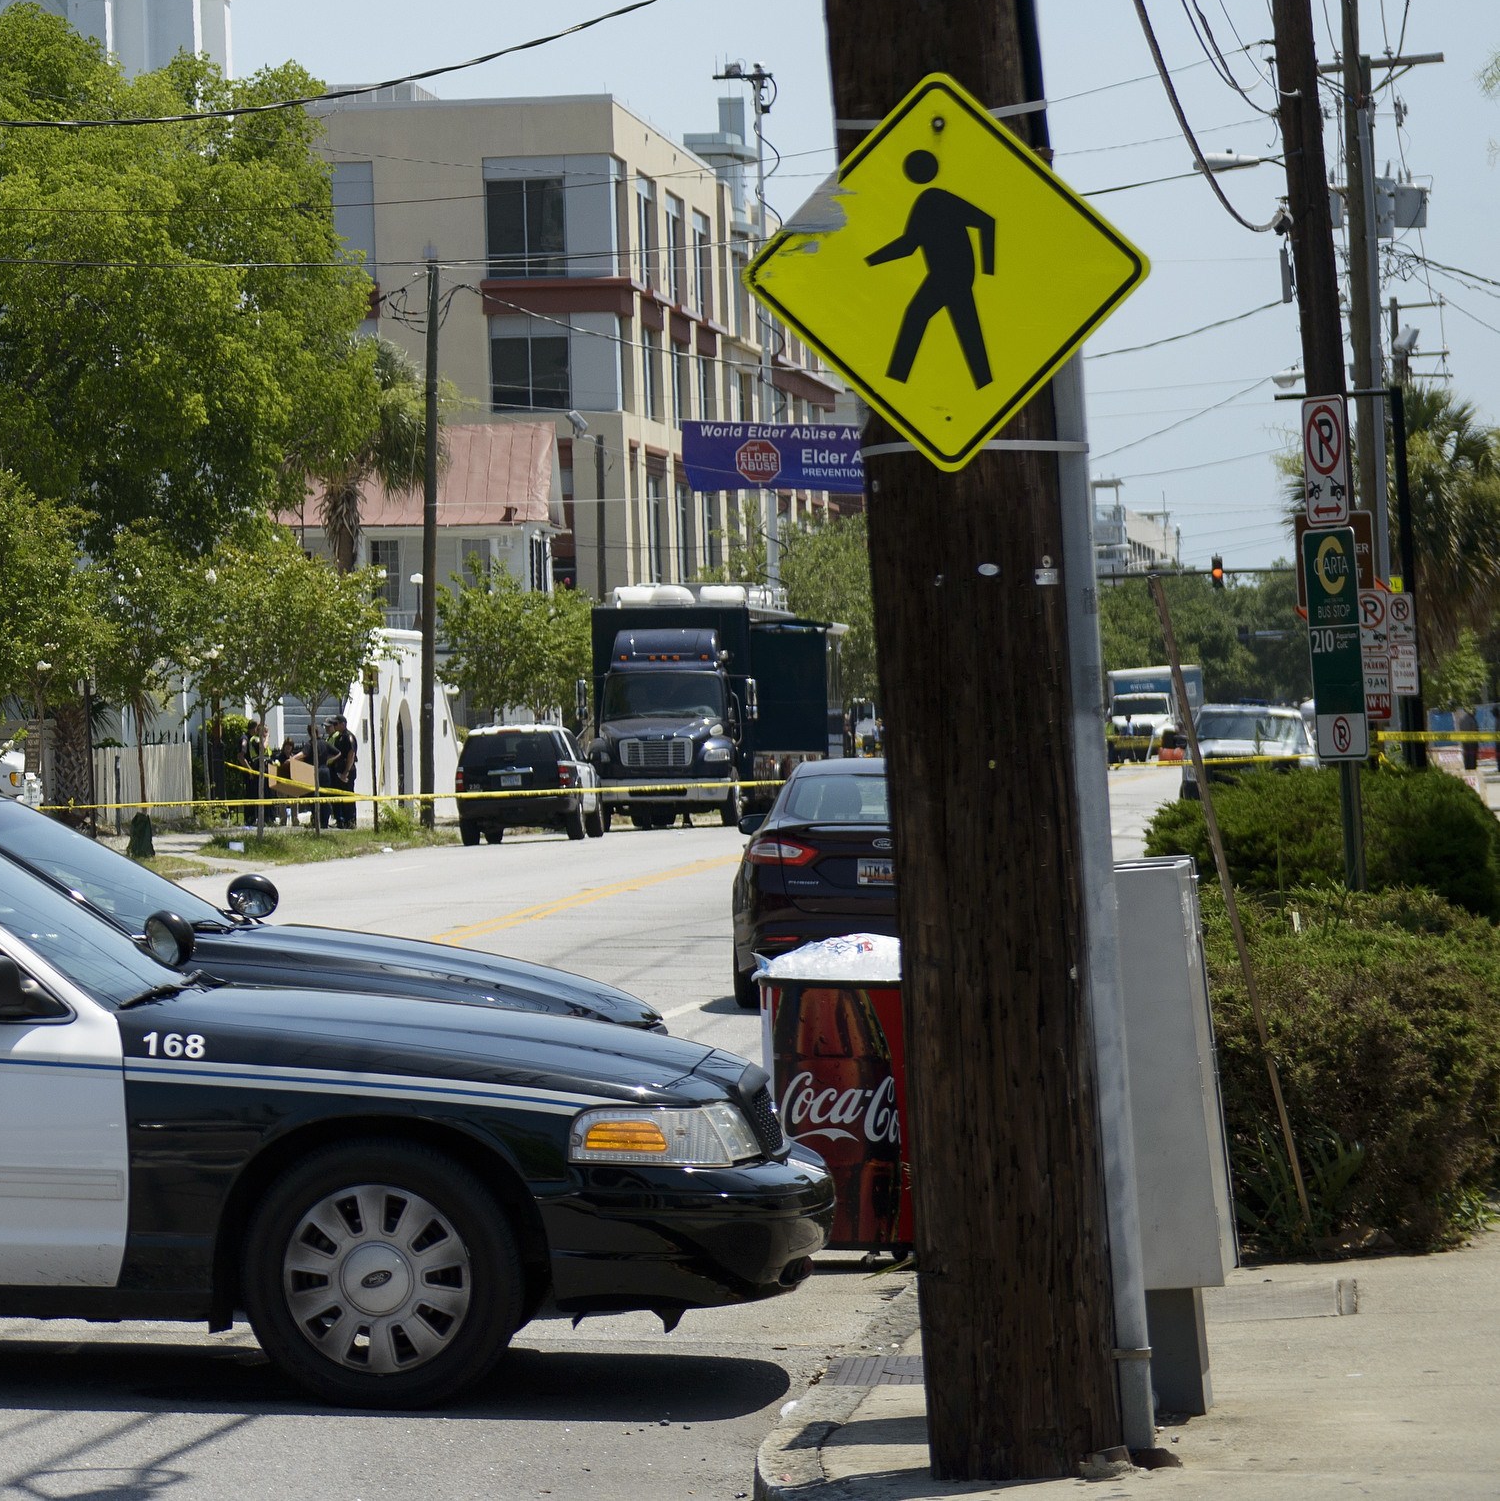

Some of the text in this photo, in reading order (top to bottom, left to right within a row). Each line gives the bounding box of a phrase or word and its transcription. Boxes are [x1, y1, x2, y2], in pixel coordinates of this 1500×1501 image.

[700, 424, 862, 440] World Elder Abuse Aw
[739, 452, 777, 462] ELDER
[801, 449, 864, 464] Elder A
[739, 462, 778, 472] ABUSE
[802, 468, 865, 477] PREVENTION
[1313, 555, 1349, 576] CARTA
[1317, 604, 1350, 618] BUS STOP
[1311, 629, 1335, 653] 210
[1364, 661, 1388, 670] PARKING
[861, 865, 880, 877] JTM
[142, 1031, 206, 1059] 168
[779, 1070, 902, 1144] Coca-Co
